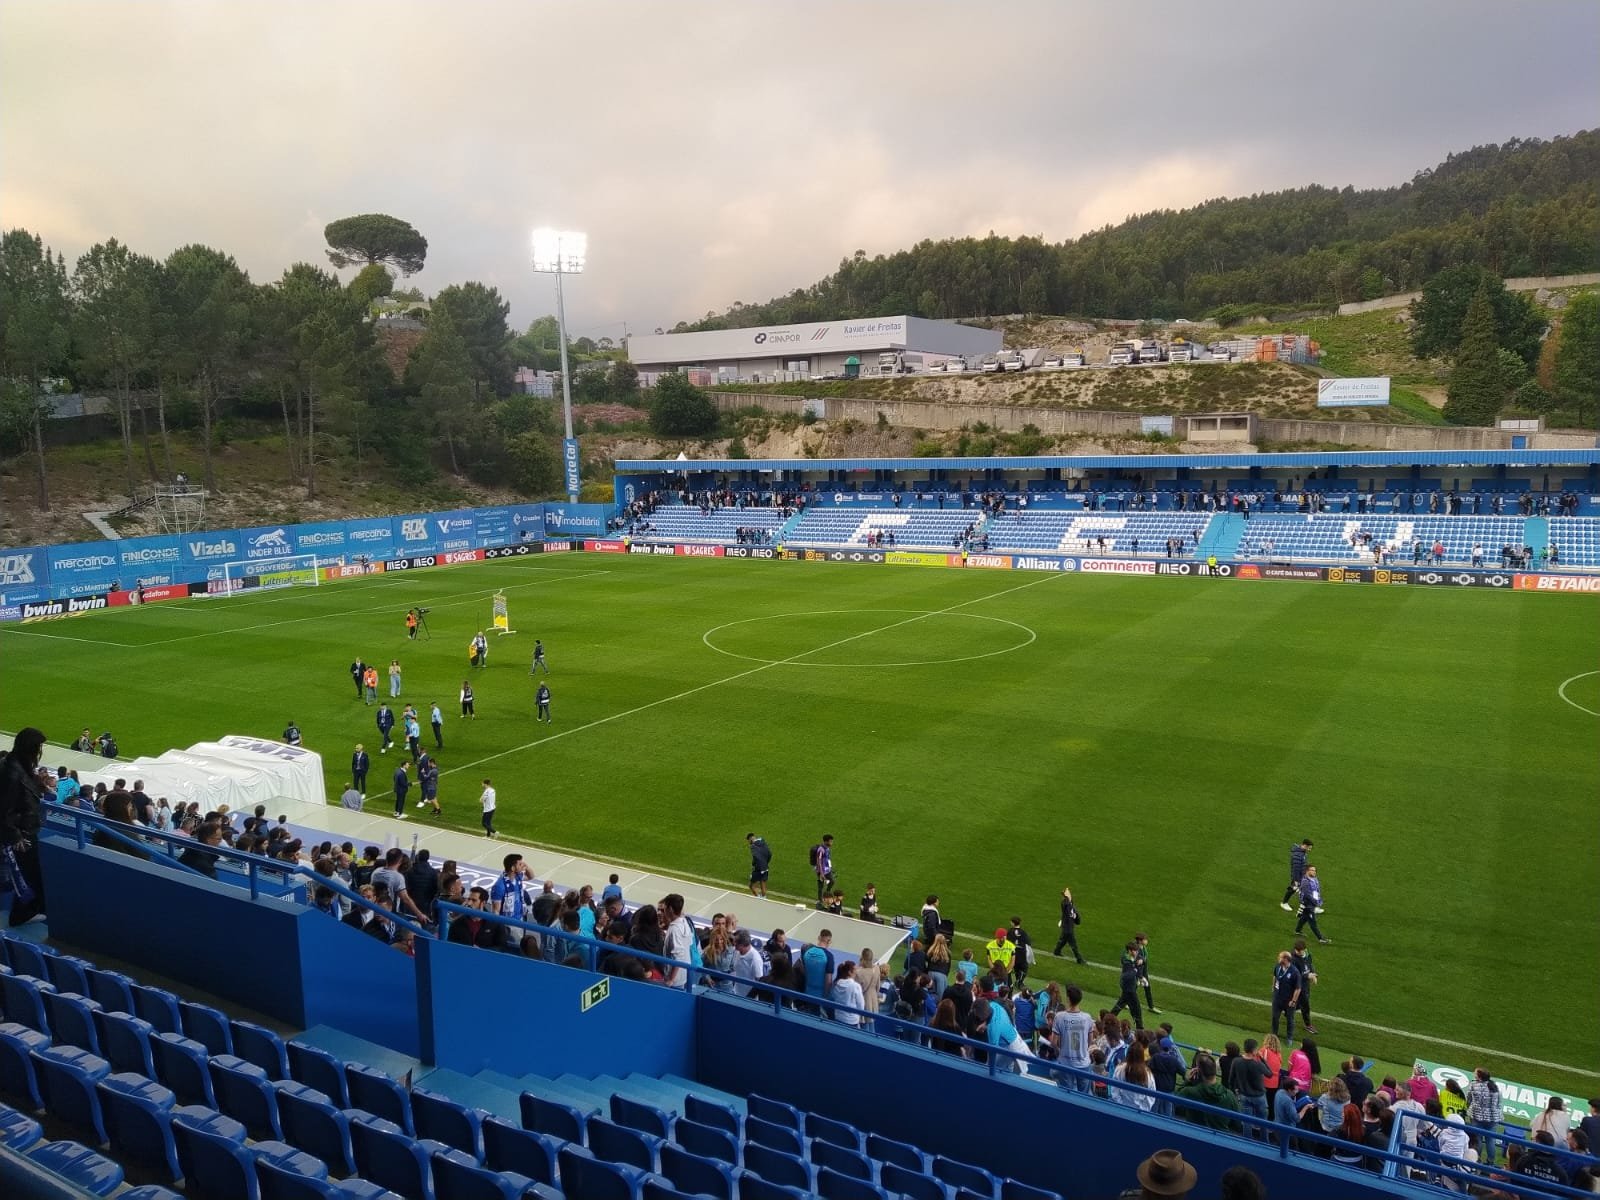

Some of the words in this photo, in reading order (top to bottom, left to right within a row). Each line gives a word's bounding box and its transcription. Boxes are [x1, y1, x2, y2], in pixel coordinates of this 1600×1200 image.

[844, 326, 865, 335] Xavier
[867, 324, 876, 333] de
[877, 322, 902, 332] Freitas
[568, 460, 578, 491] Norte
[545, 512, 562, 528] Fly
[188, 539, 236, 557] Vizela
[247, 547, 273, 558] UNDER
[274, 544, 293, 555] BLUE
[630, 543, 651, 554] bwin
[653, 544, 675, 555] bwin
[691, 545, 716, 556] SAGRES
[726, 547, 747, 557] MEO
[751, 549, 773, 558] MEO
[386, 559, 409, 571] MEO
[413, 556, 435, 568] MEO
[452, 550, 477, 564] SAGRES
[1017, 557, 1060, 570] Allianz
[1082, 560, 1155, 573] CONTINENTE
[1159, 563, 1191, 575] MEO
[1419, 572, 1443, 584] NOS
[1451, 573, 1476, 585] NOS
[1485, 575, 1509, 587] NOS
[23, 600, 63, 618] bwin
[68, 595, 106, 612] bwin
